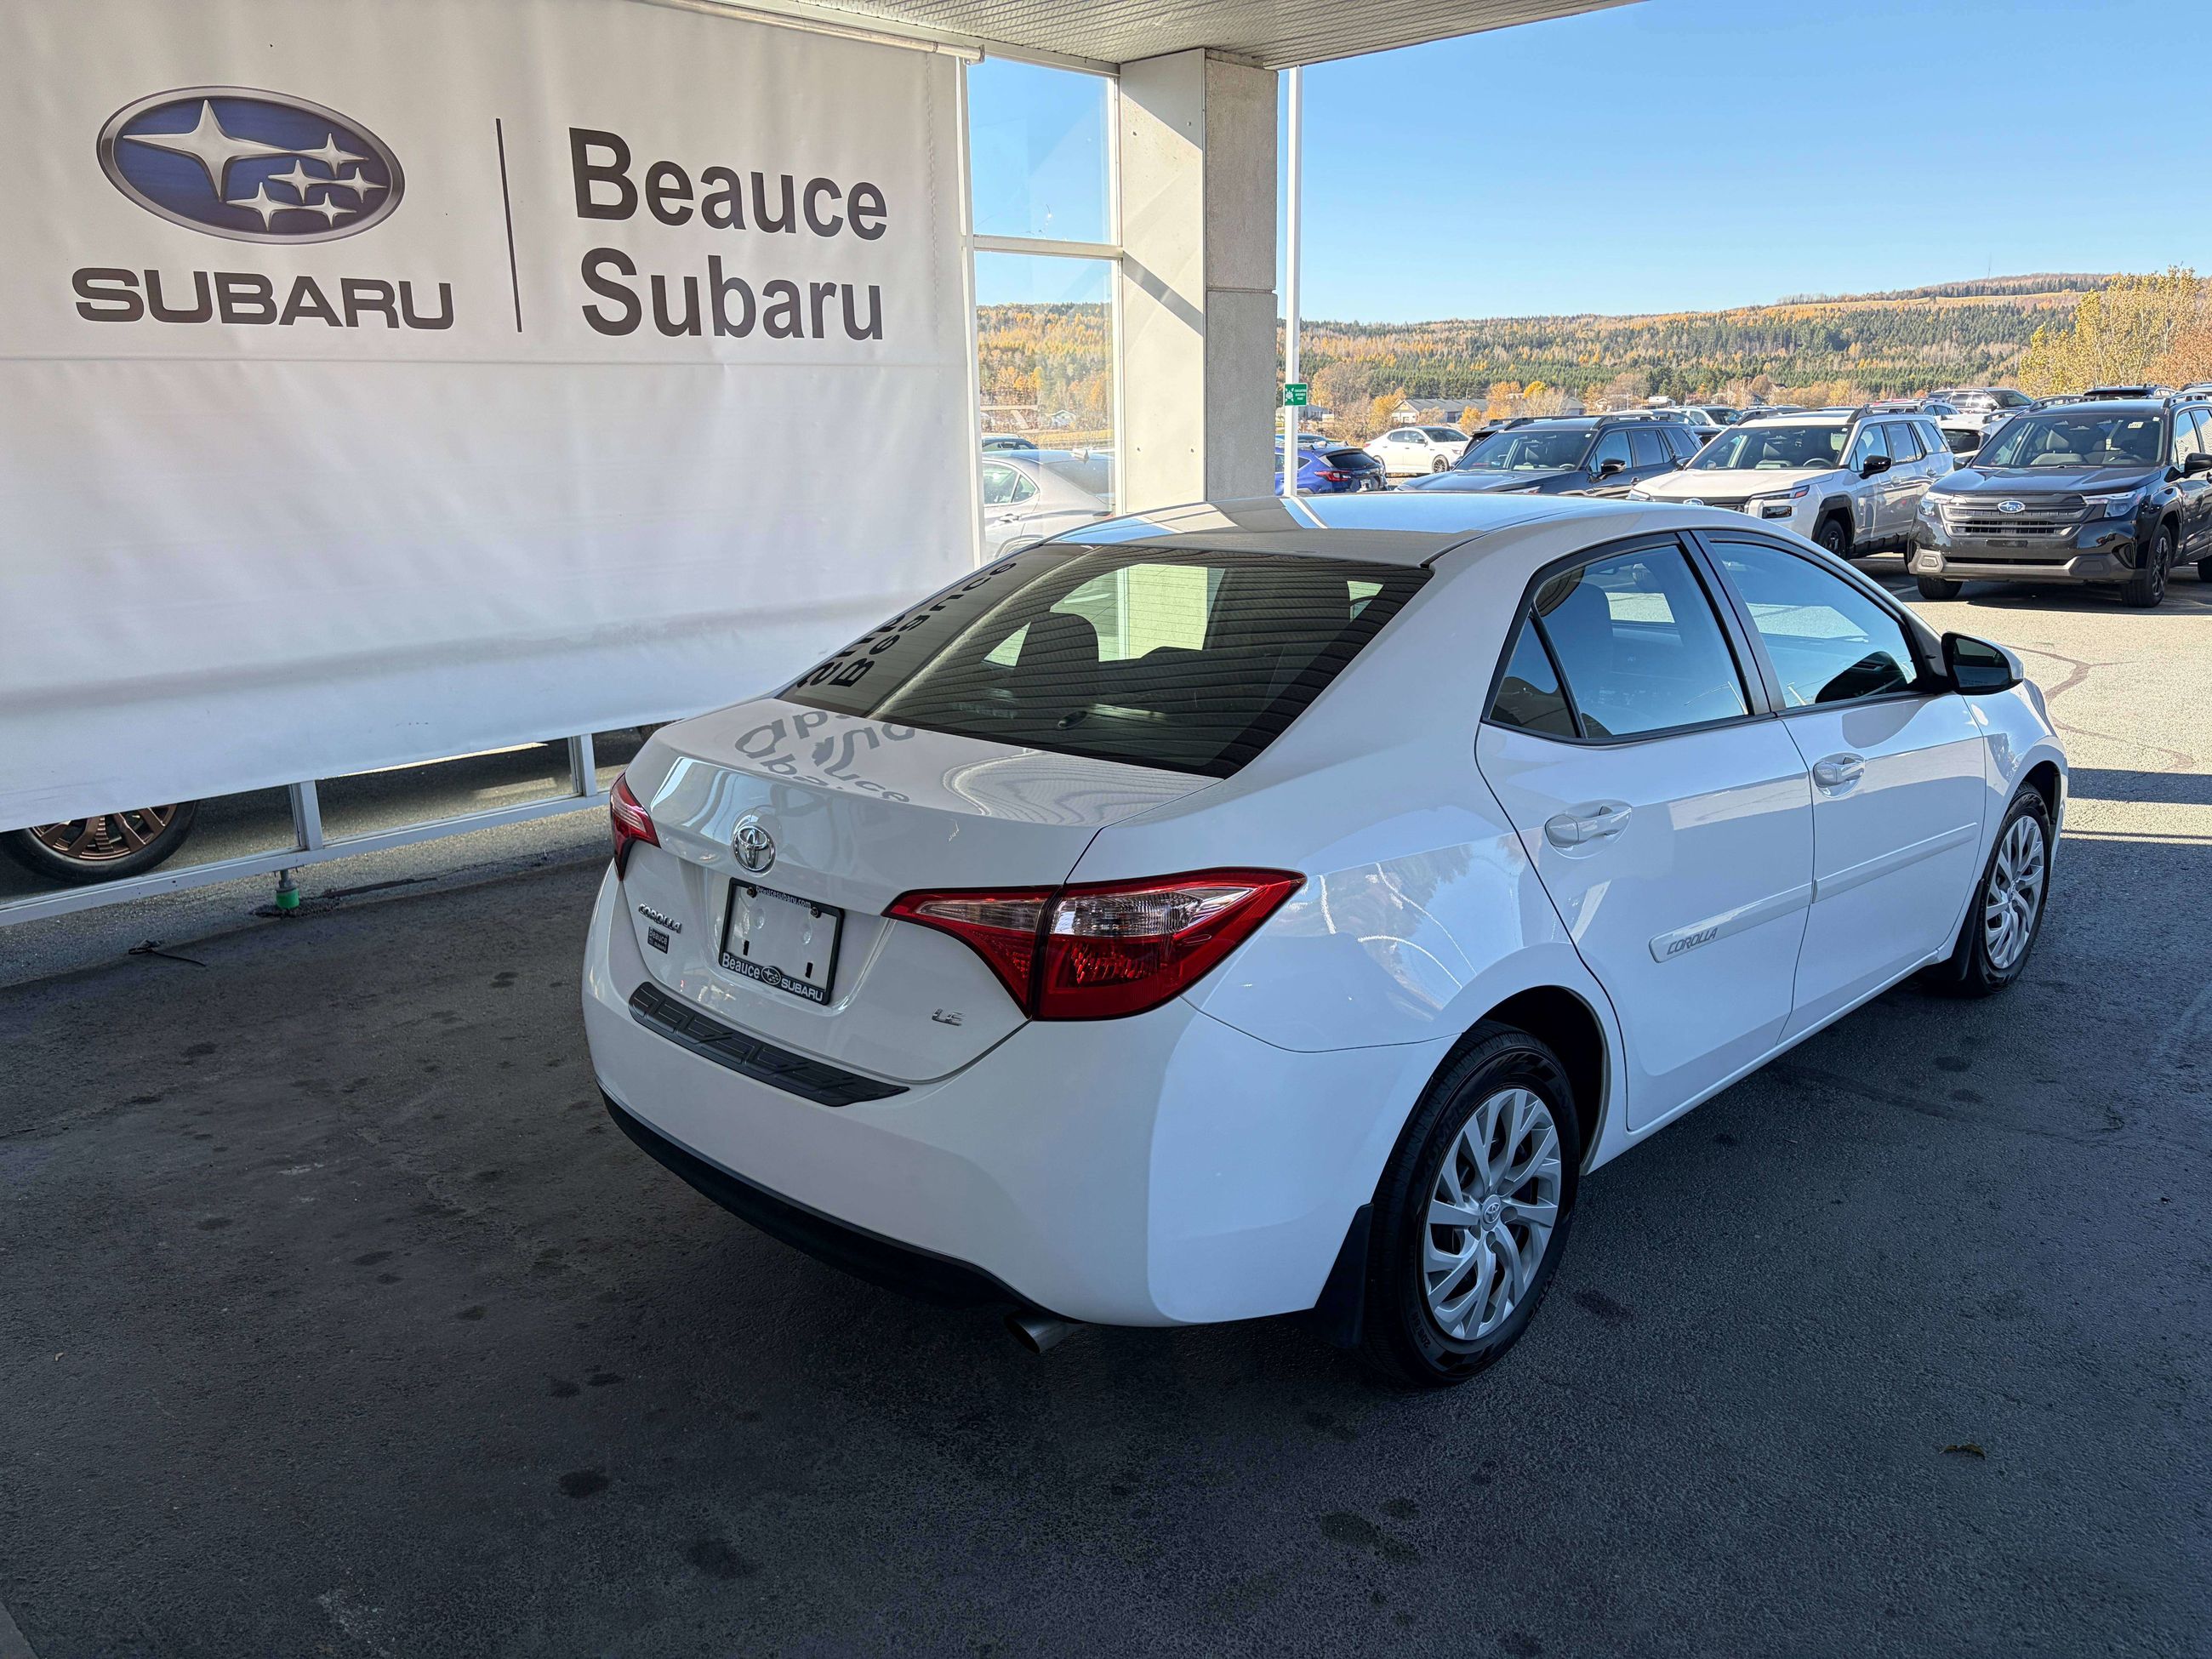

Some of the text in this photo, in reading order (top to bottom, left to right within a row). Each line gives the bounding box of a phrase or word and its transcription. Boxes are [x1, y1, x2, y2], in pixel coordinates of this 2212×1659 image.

[569, 127, 887, 241] Beauce
[72, 267, 454, 329] SUBARU
[581, 248, 883, 340] Subaru
[755, 886, 812, 909] beaucesubaru.com
[638, 903, 681, 933] COROLLA
[1667, 927, 1719, 955] COROLLA
[721, 953, 823, 1001] Beauce SUBARU
[932, 1008, 964, 1026] LE
